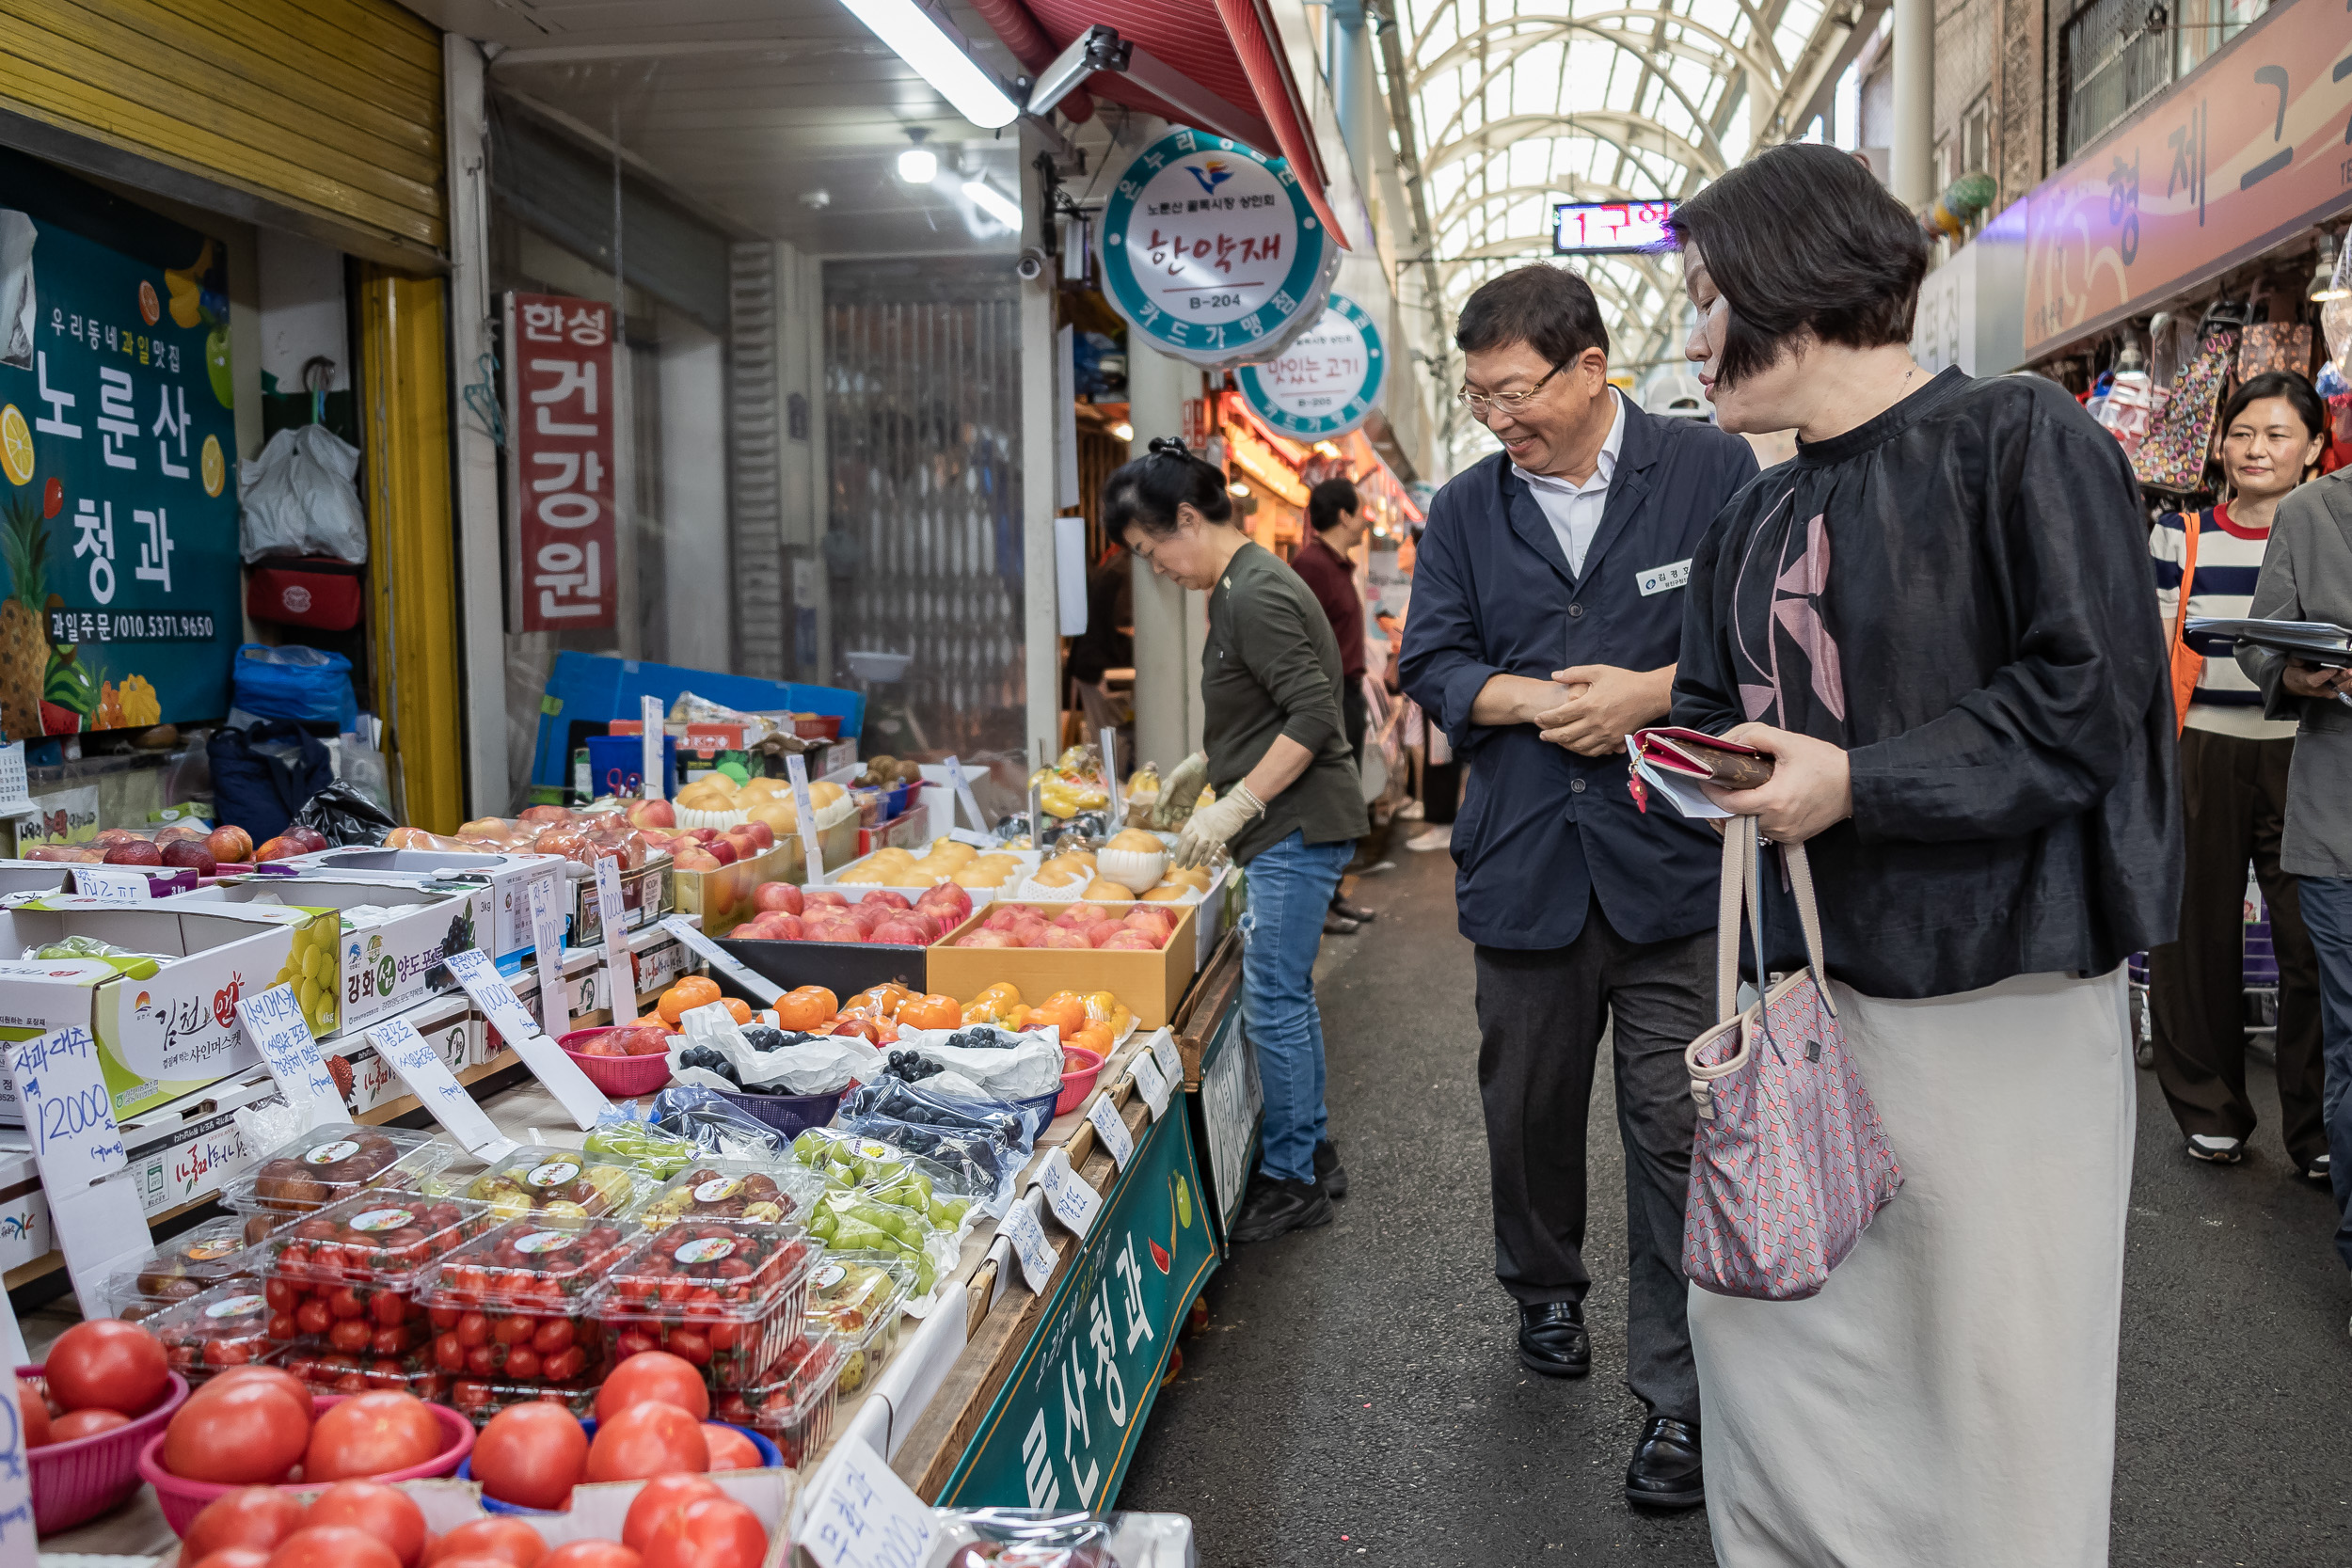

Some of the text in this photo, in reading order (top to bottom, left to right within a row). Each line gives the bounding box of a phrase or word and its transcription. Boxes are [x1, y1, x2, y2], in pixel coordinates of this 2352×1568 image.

[1239, 193, 1276, 209] 상인회
[1146, 229, 1281, 276] 한약재
[1139, 289, 1299, 350] 카드가맹점
[1189, 293, 1241, 310] B-204
[523, 303, 607, 347] 한성
[1326, 357, 1359, 378] 고기
[36, 349, 192, 480] 노룬산
[530, 356, 608, 619] 건강원
[72, 498, 175, 605] 청과
[322, 1012, 335, 1024] 4kg
